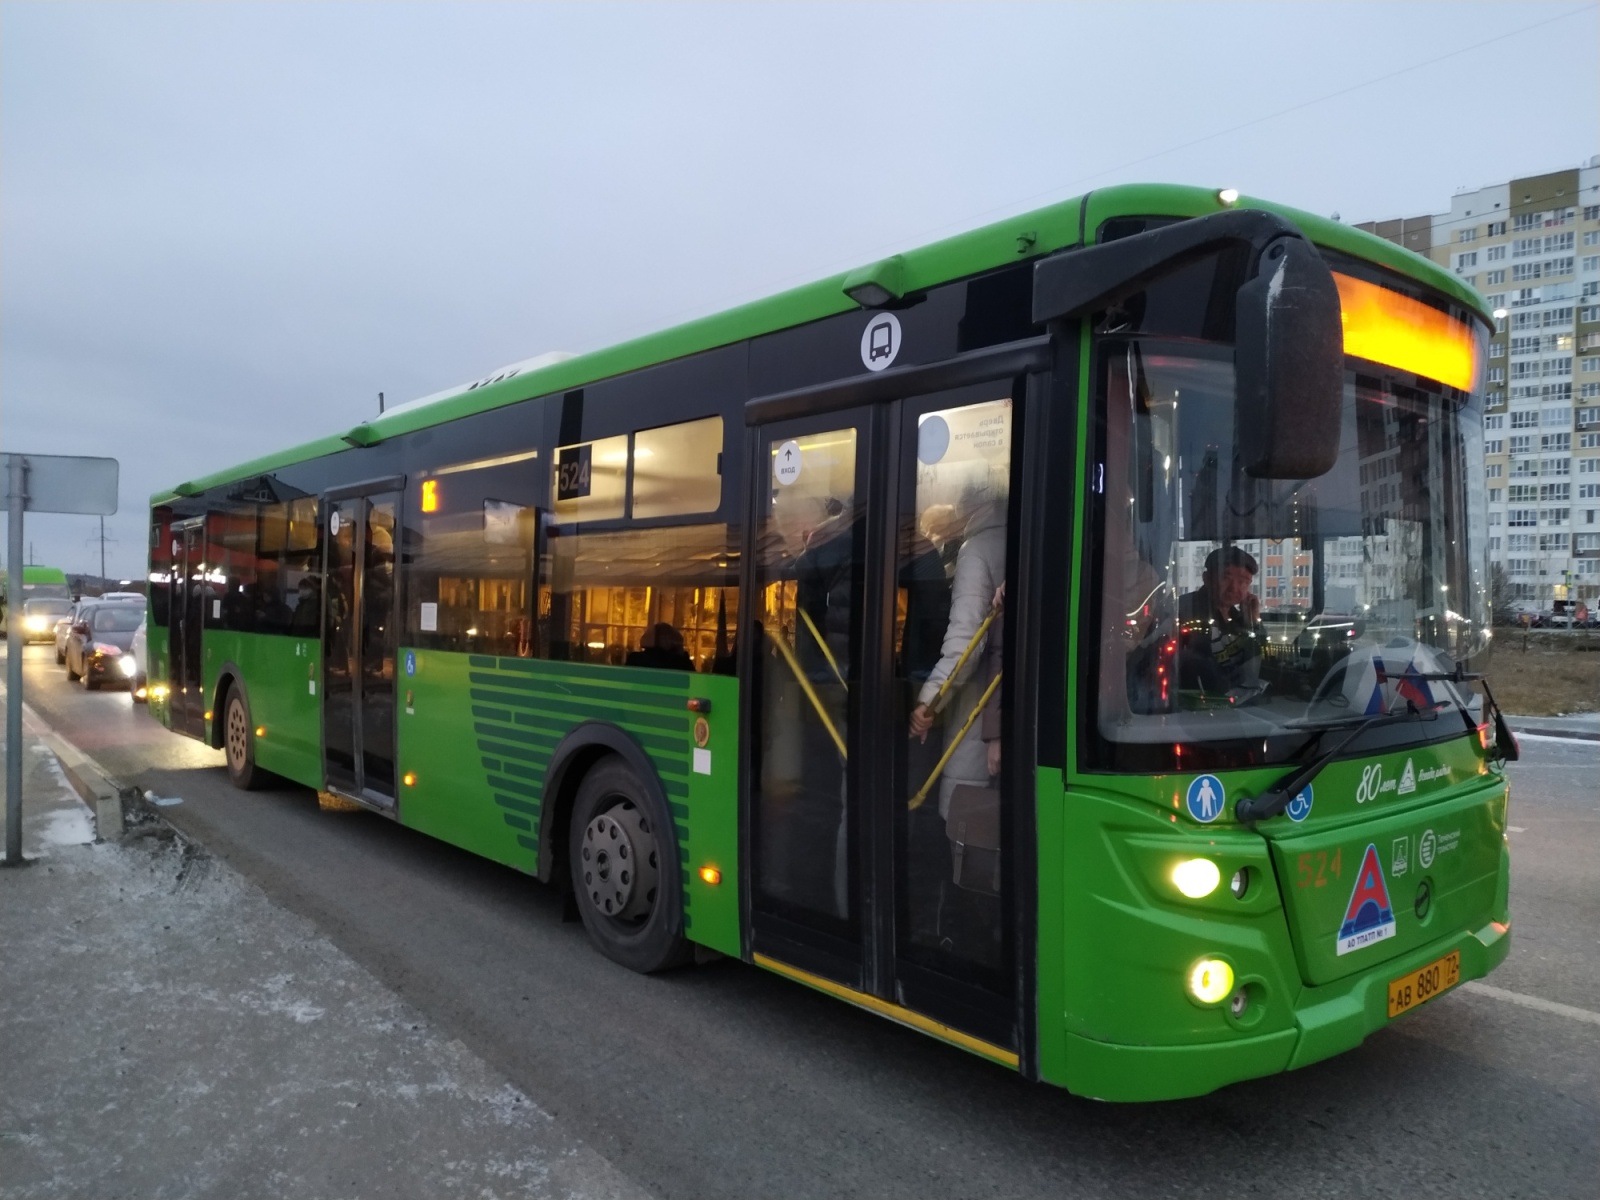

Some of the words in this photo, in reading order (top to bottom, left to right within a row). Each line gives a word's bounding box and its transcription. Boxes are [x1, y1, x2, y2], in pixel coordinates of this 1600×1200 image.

[560, 459, 590, 492] 524
[1356, 763, 1382, 804] 80
[1296, 847, 1342, 889] 524
[1347, 938, 1356, 949] АО
[1356, 930, 1376, 946] ТПАТП
[1396, 985, 1411, 1011] АВ
[1417, 965, 1440, 999] 880
[1446, 955, 1457, 977] 72
